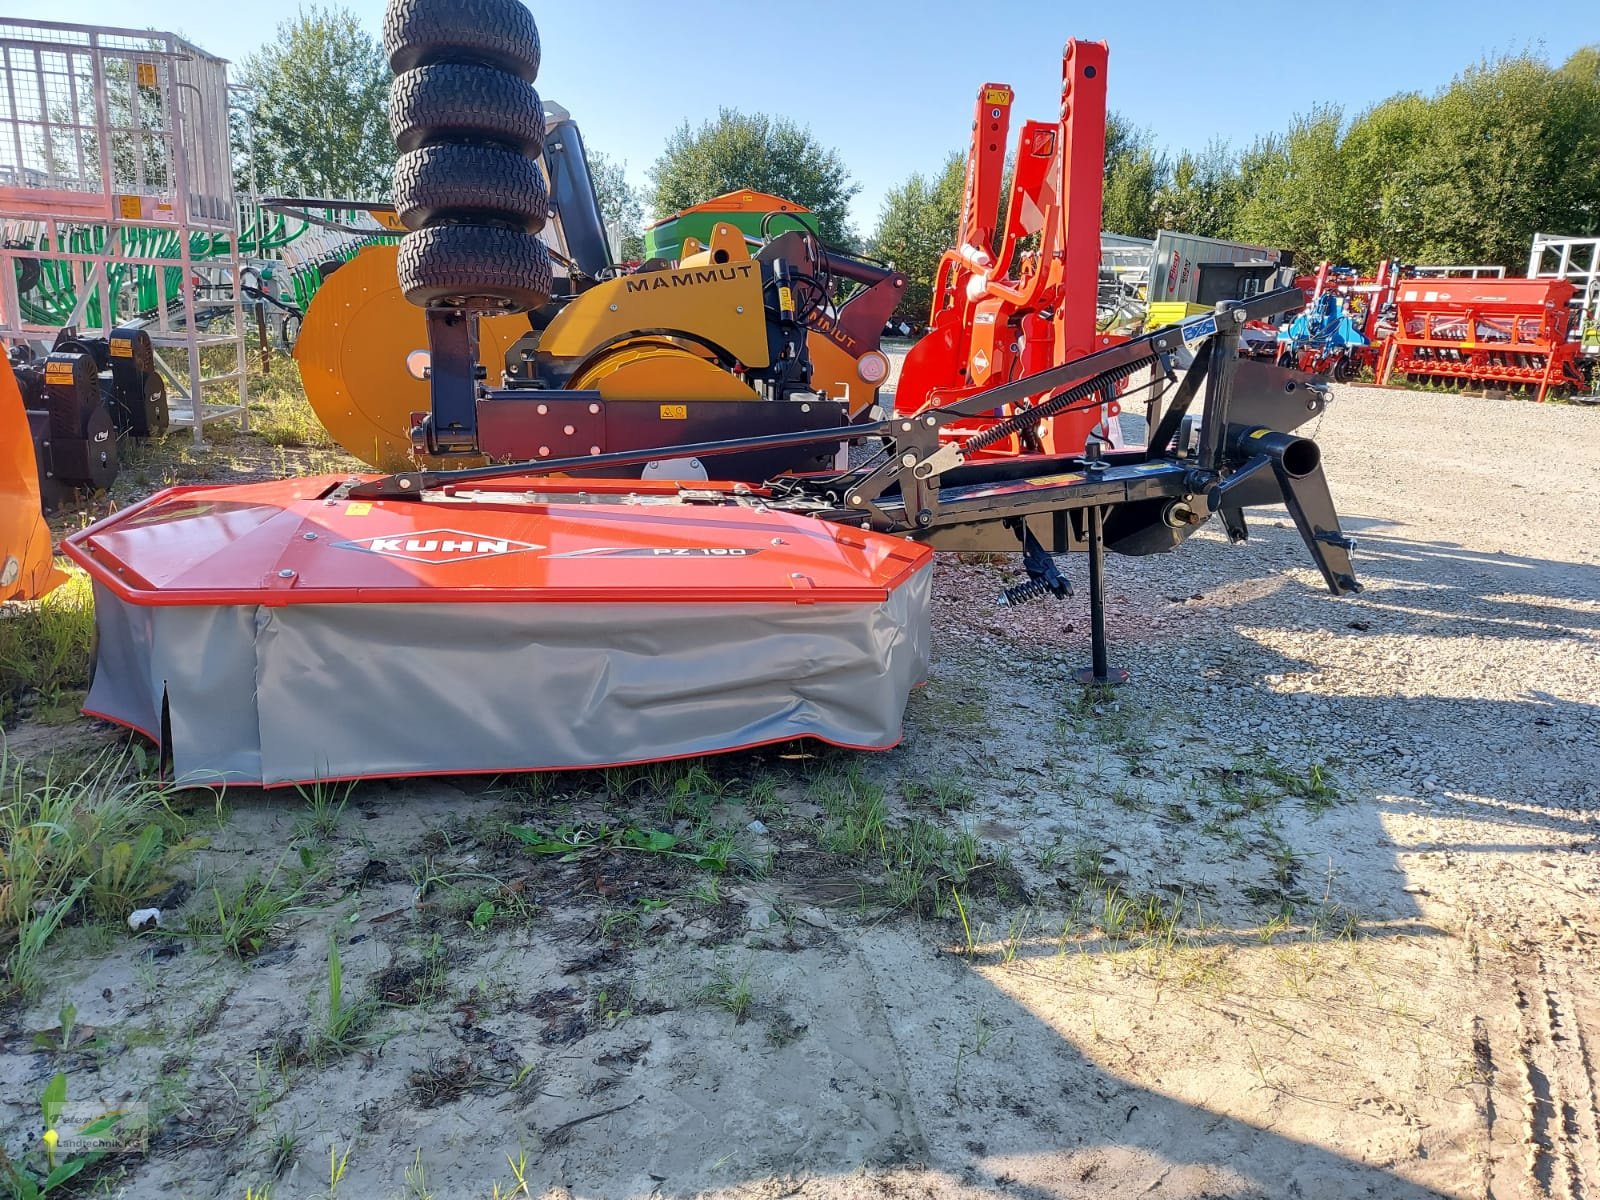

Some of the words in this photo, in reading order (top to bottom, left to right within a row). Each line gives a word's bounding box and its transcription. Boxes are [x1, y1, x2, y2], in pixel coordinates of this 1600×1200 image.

[626, 266, 752, 293] MAMMUT
[370, 538, 508, 553] KUHN
[653, 548, 690, 556] PZ
[701, 548, 747, 556] 190
